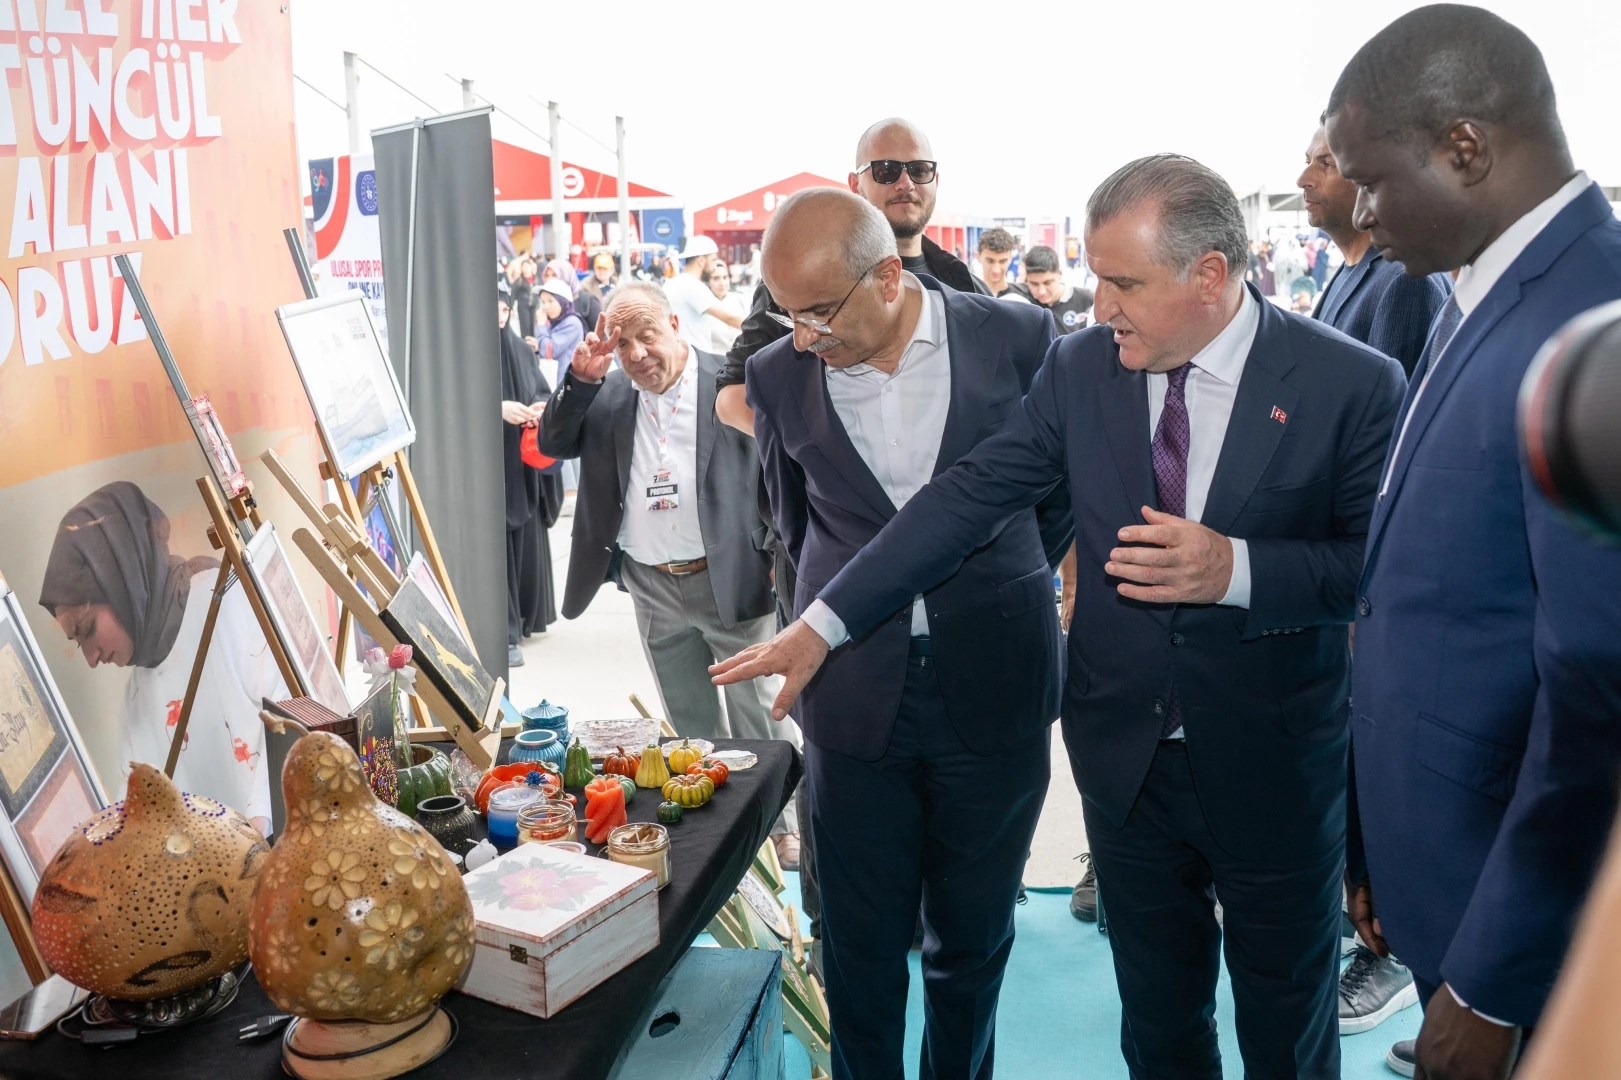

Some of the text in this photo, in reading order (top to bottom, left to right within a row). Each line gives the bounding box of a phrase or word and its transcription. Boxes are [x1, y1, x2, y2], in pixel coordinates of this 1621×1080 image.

[8, 148, 192, 258] ALANI
[331, 260, 354, 277] ULUSAL
[354, 260, 372, 278] SPOR
[650, 486, 675, 496] PROTOKOL
